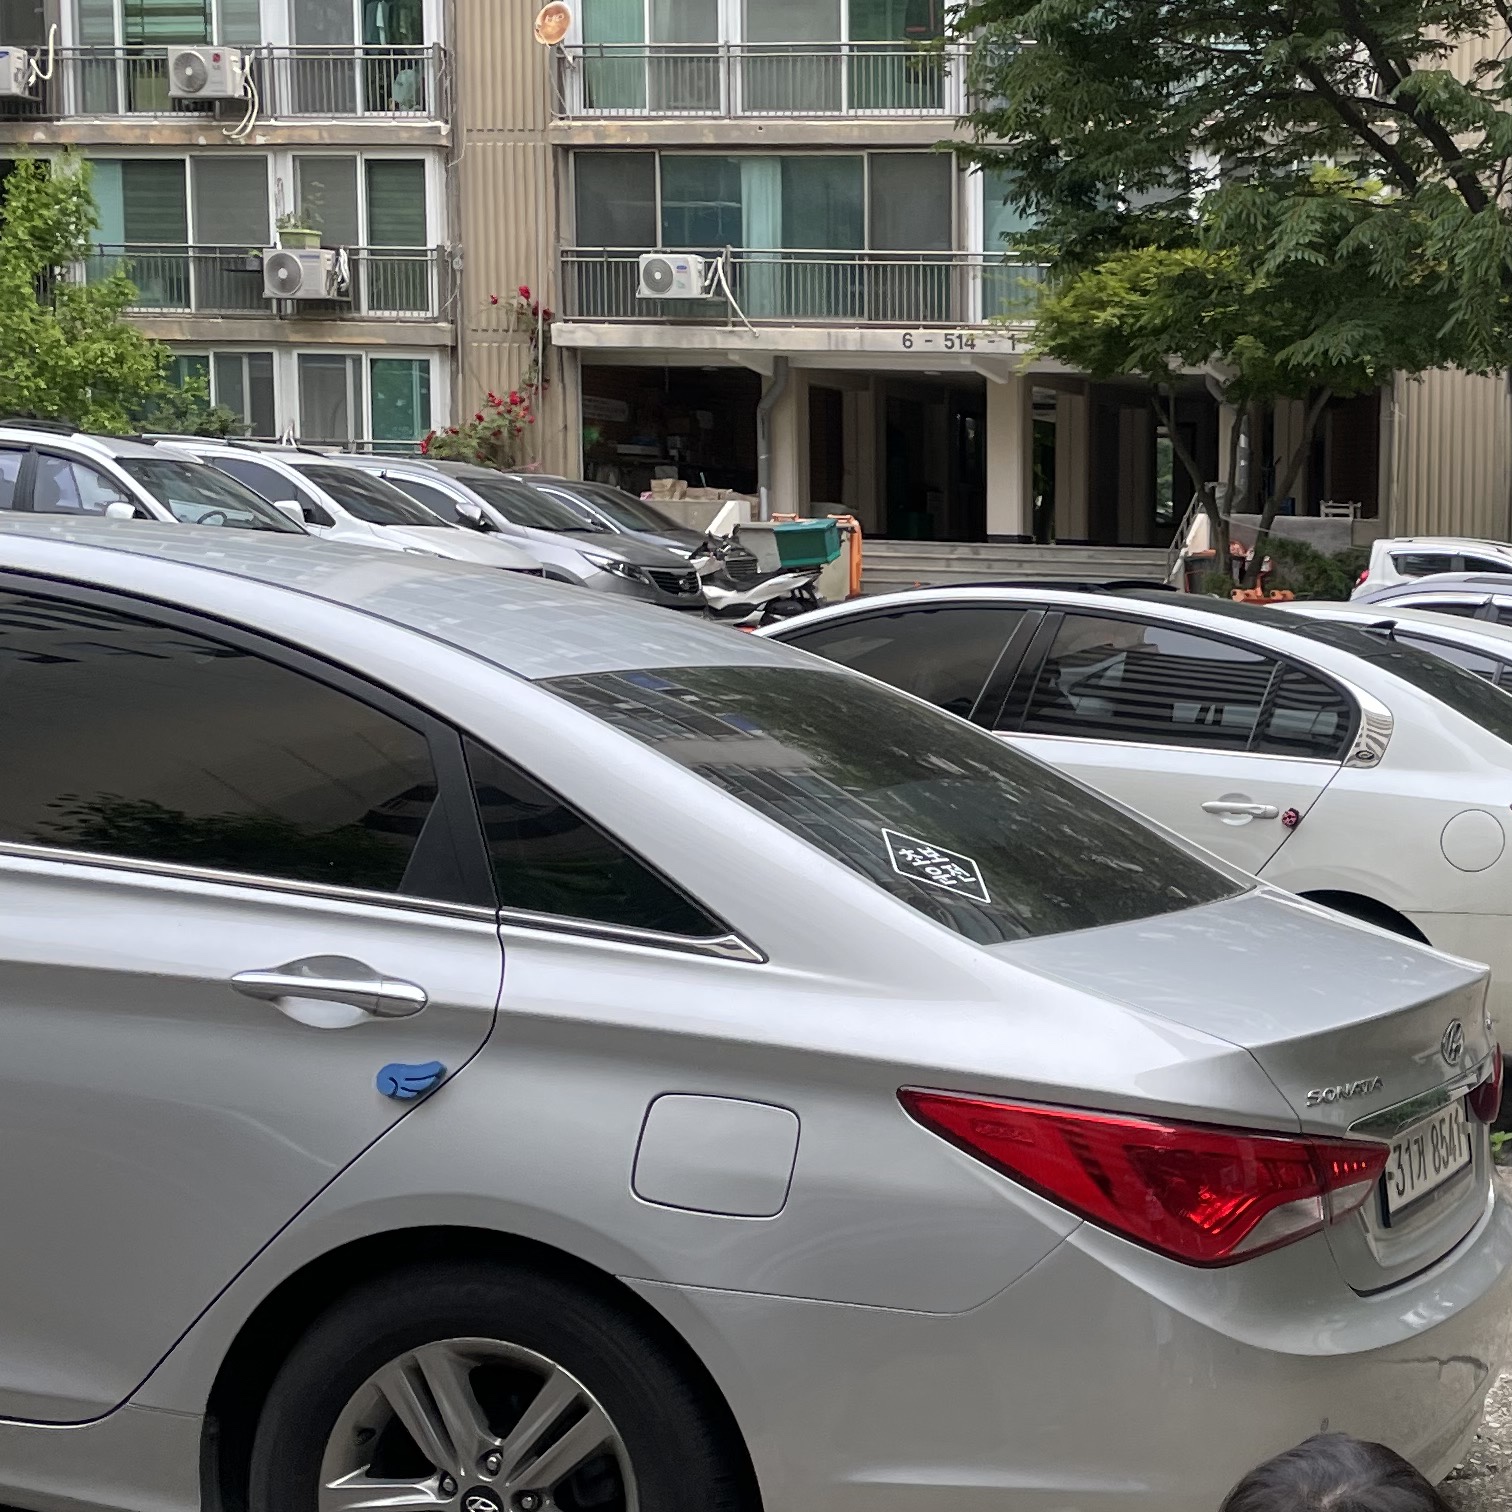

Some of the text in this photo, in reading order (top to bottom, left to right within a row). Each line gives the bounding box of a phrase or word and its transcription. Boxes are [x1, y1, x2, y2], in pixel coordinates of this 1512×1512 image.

[902, 332, 913, 349] 6
[944, 333, 976, 350] 514
[1306, 1076, 1384, 1107] SONATA
